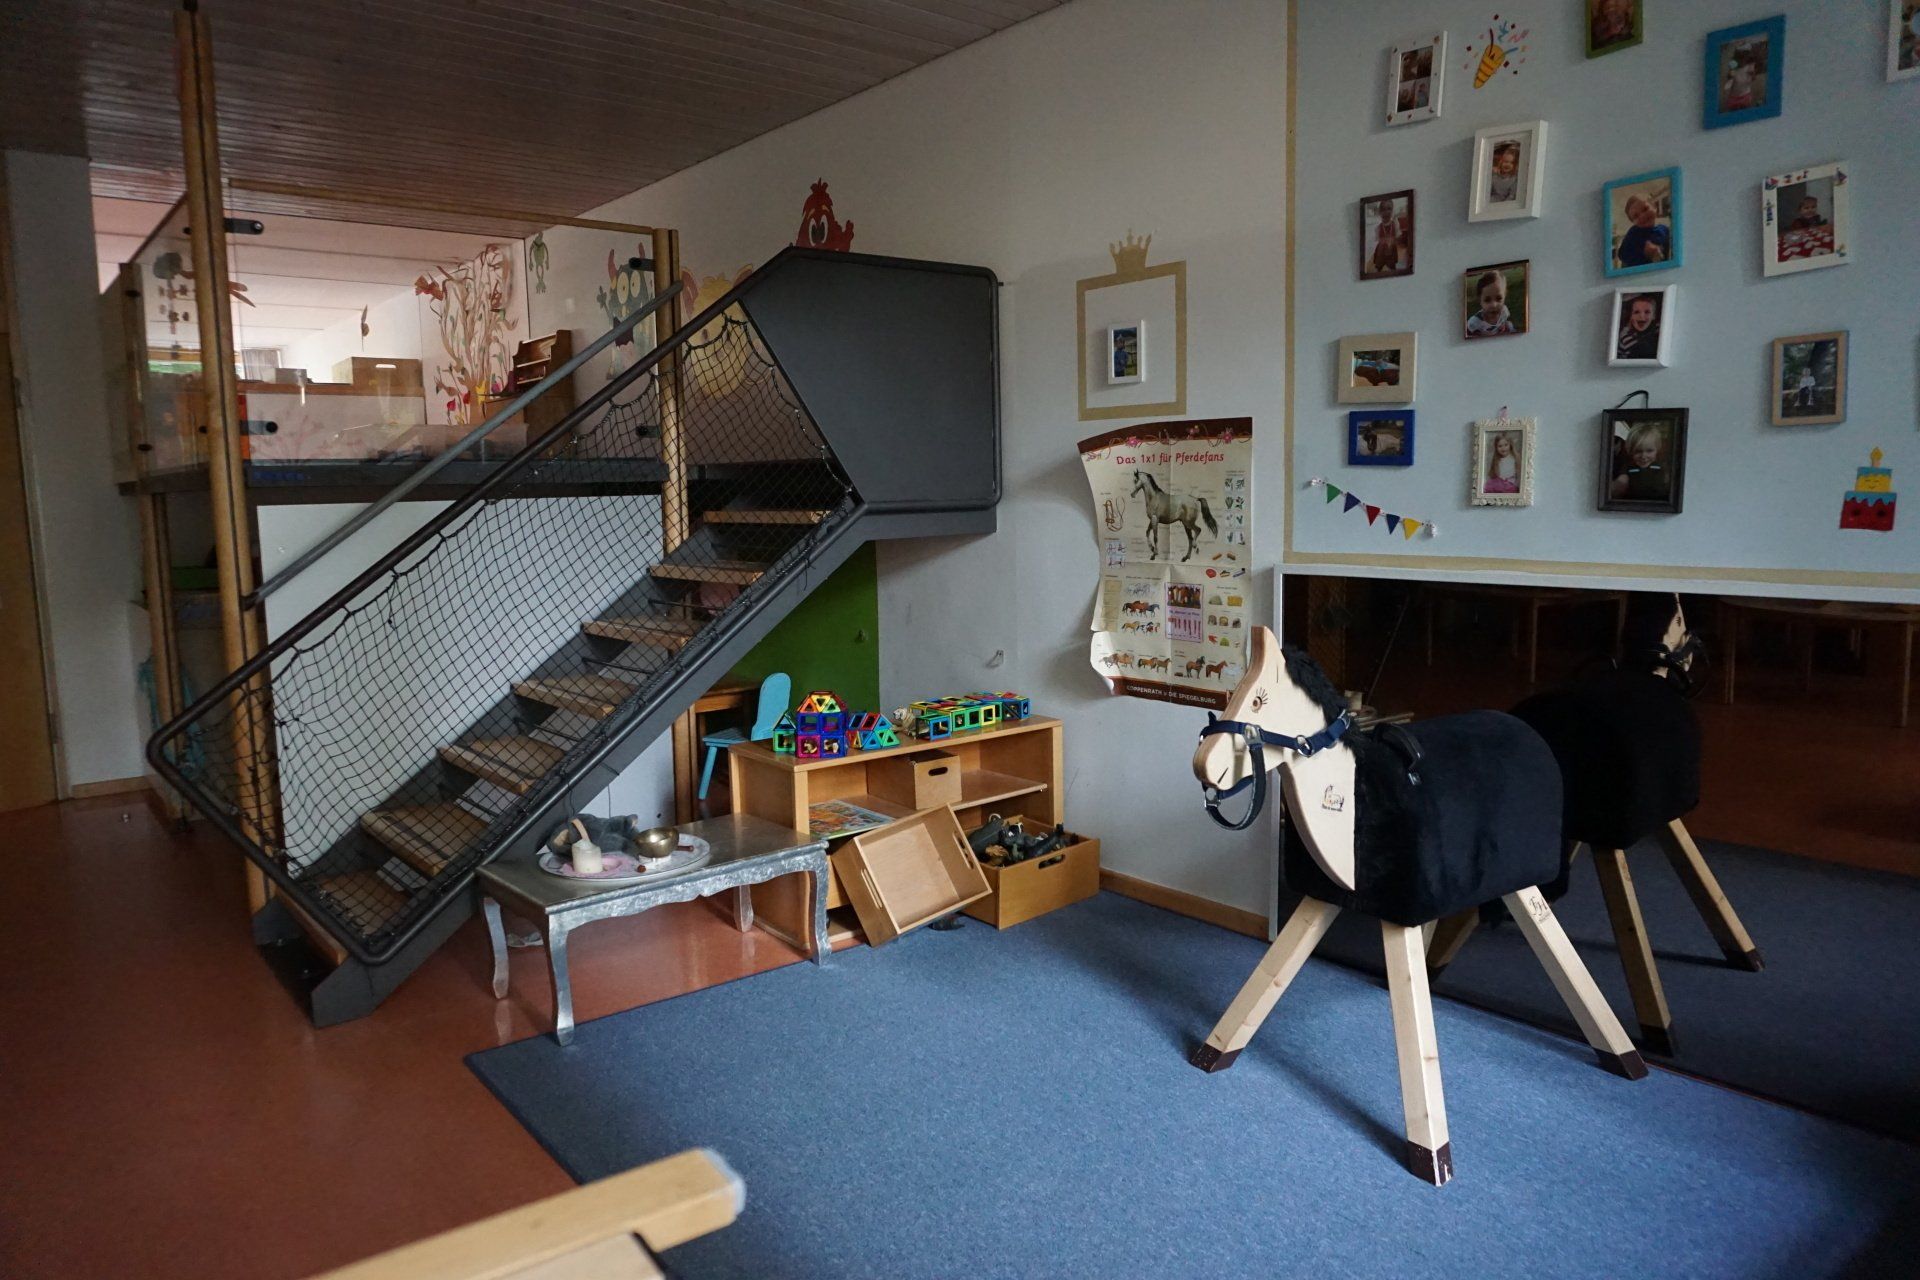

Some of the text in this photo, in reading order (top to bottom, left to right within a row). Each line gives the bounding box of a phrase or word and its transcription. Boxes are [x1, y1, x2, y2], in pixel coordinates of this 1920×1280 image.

[1116, 451, 1224, 465] Das 1x1 für Pferdefans
[1126, 685, 1162, 695] COPPENRATH
[1178, 693, 1217, 704] SPIEGELBURG
